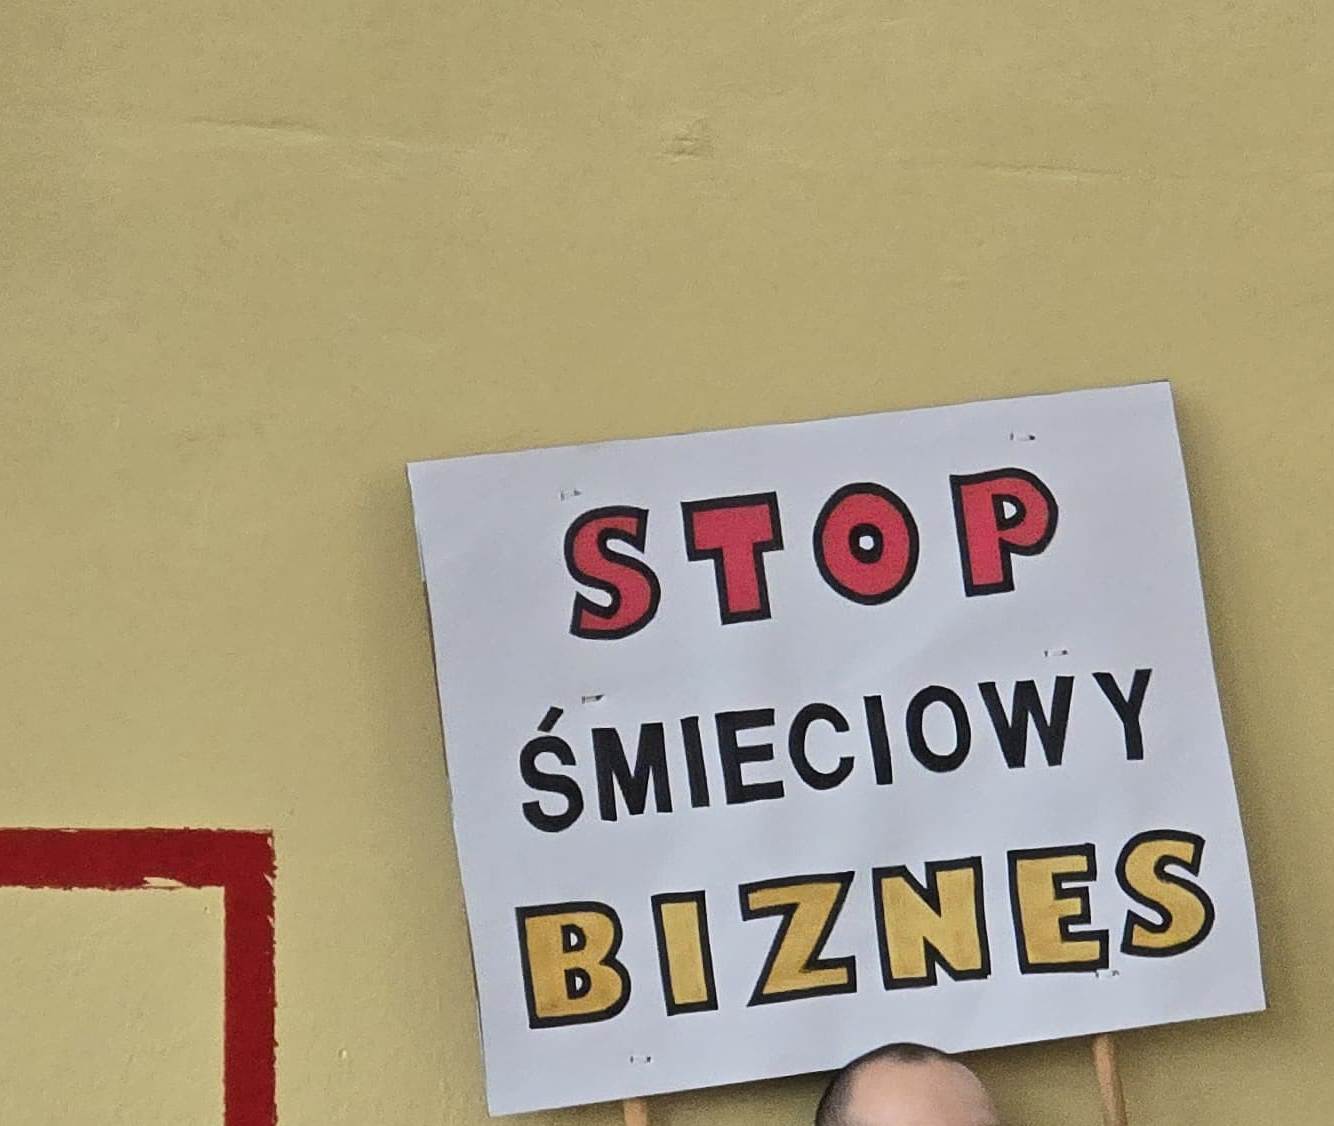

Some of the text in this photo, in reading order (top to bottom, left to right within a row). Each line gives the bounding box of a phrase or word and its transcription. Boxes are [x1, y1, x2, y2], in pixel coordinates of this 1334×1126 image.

[563, 467, 1060, 640] STOP
[518, 669, 1153, 833] ŚMIECIOWY
[516, 829, 1216, 1030] BIZNES
